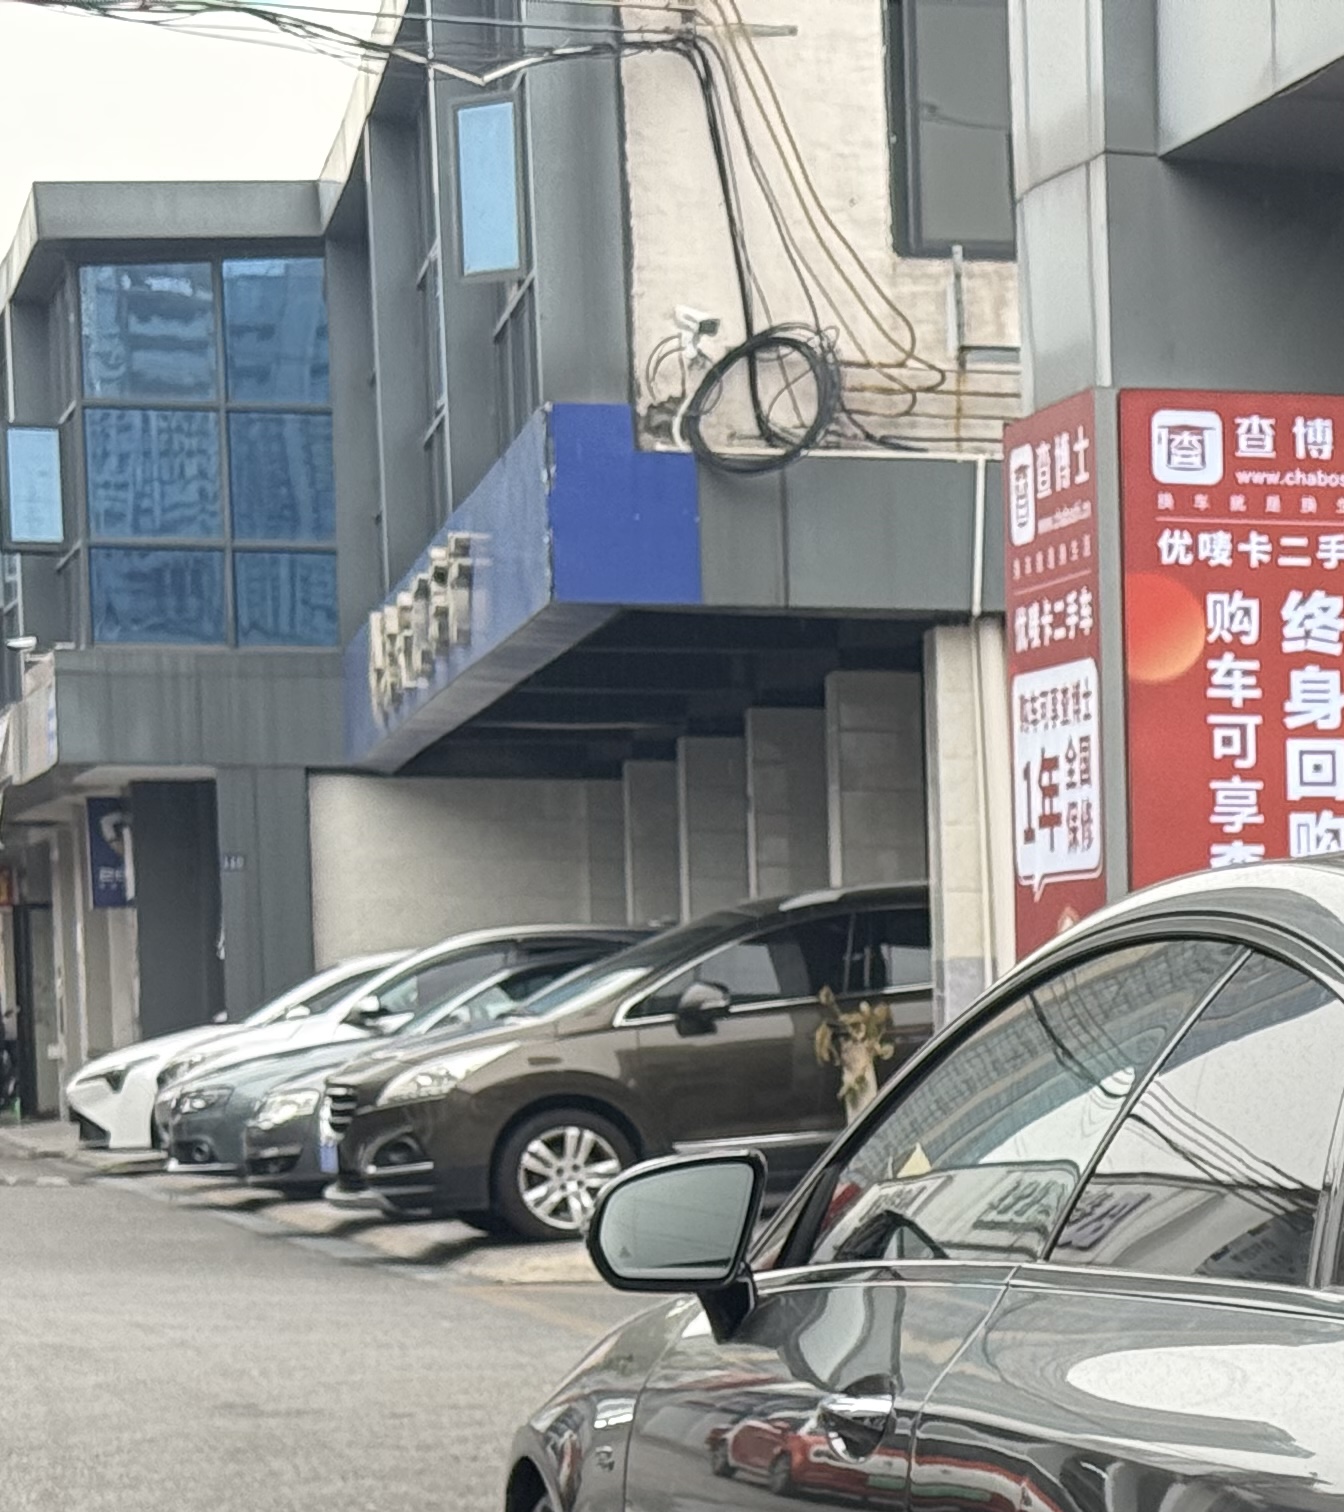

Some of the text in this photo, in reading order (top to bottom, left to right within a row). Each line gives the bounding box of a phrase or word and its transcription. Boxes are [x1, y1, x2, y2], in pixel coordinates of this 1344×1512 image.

[1036, 424, 1090, 499] 查博士
[1023, 746, 1062, 852] 1年
